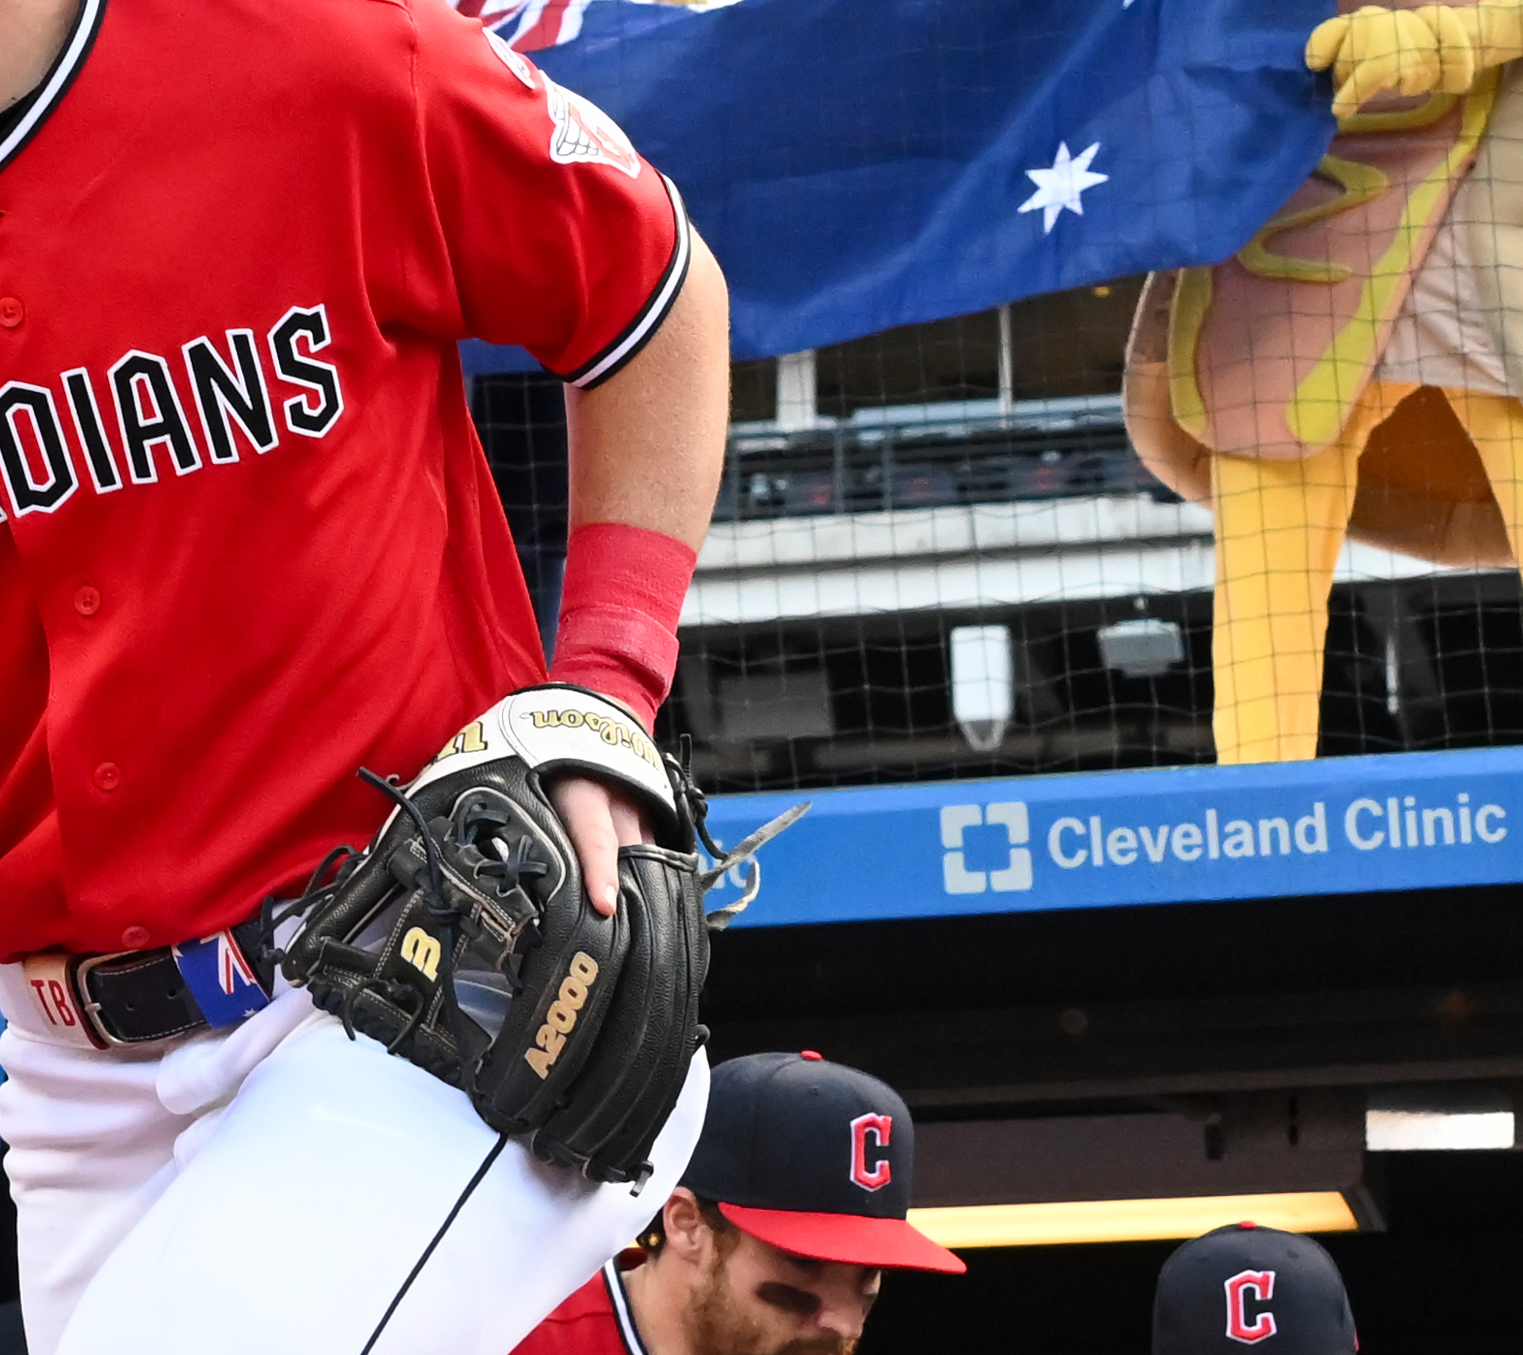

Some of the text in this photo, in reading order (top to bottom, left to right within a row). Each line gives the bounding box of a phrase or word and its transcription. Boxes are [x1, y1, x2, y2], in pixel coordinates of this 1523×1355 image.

[1046, 790, 1510, 872] Cleveland Clinic
[523, 950, 600, 1080] A2000
[850, 1111, 892, 1192] C
[1225, 1269, 1277, 1345] C
